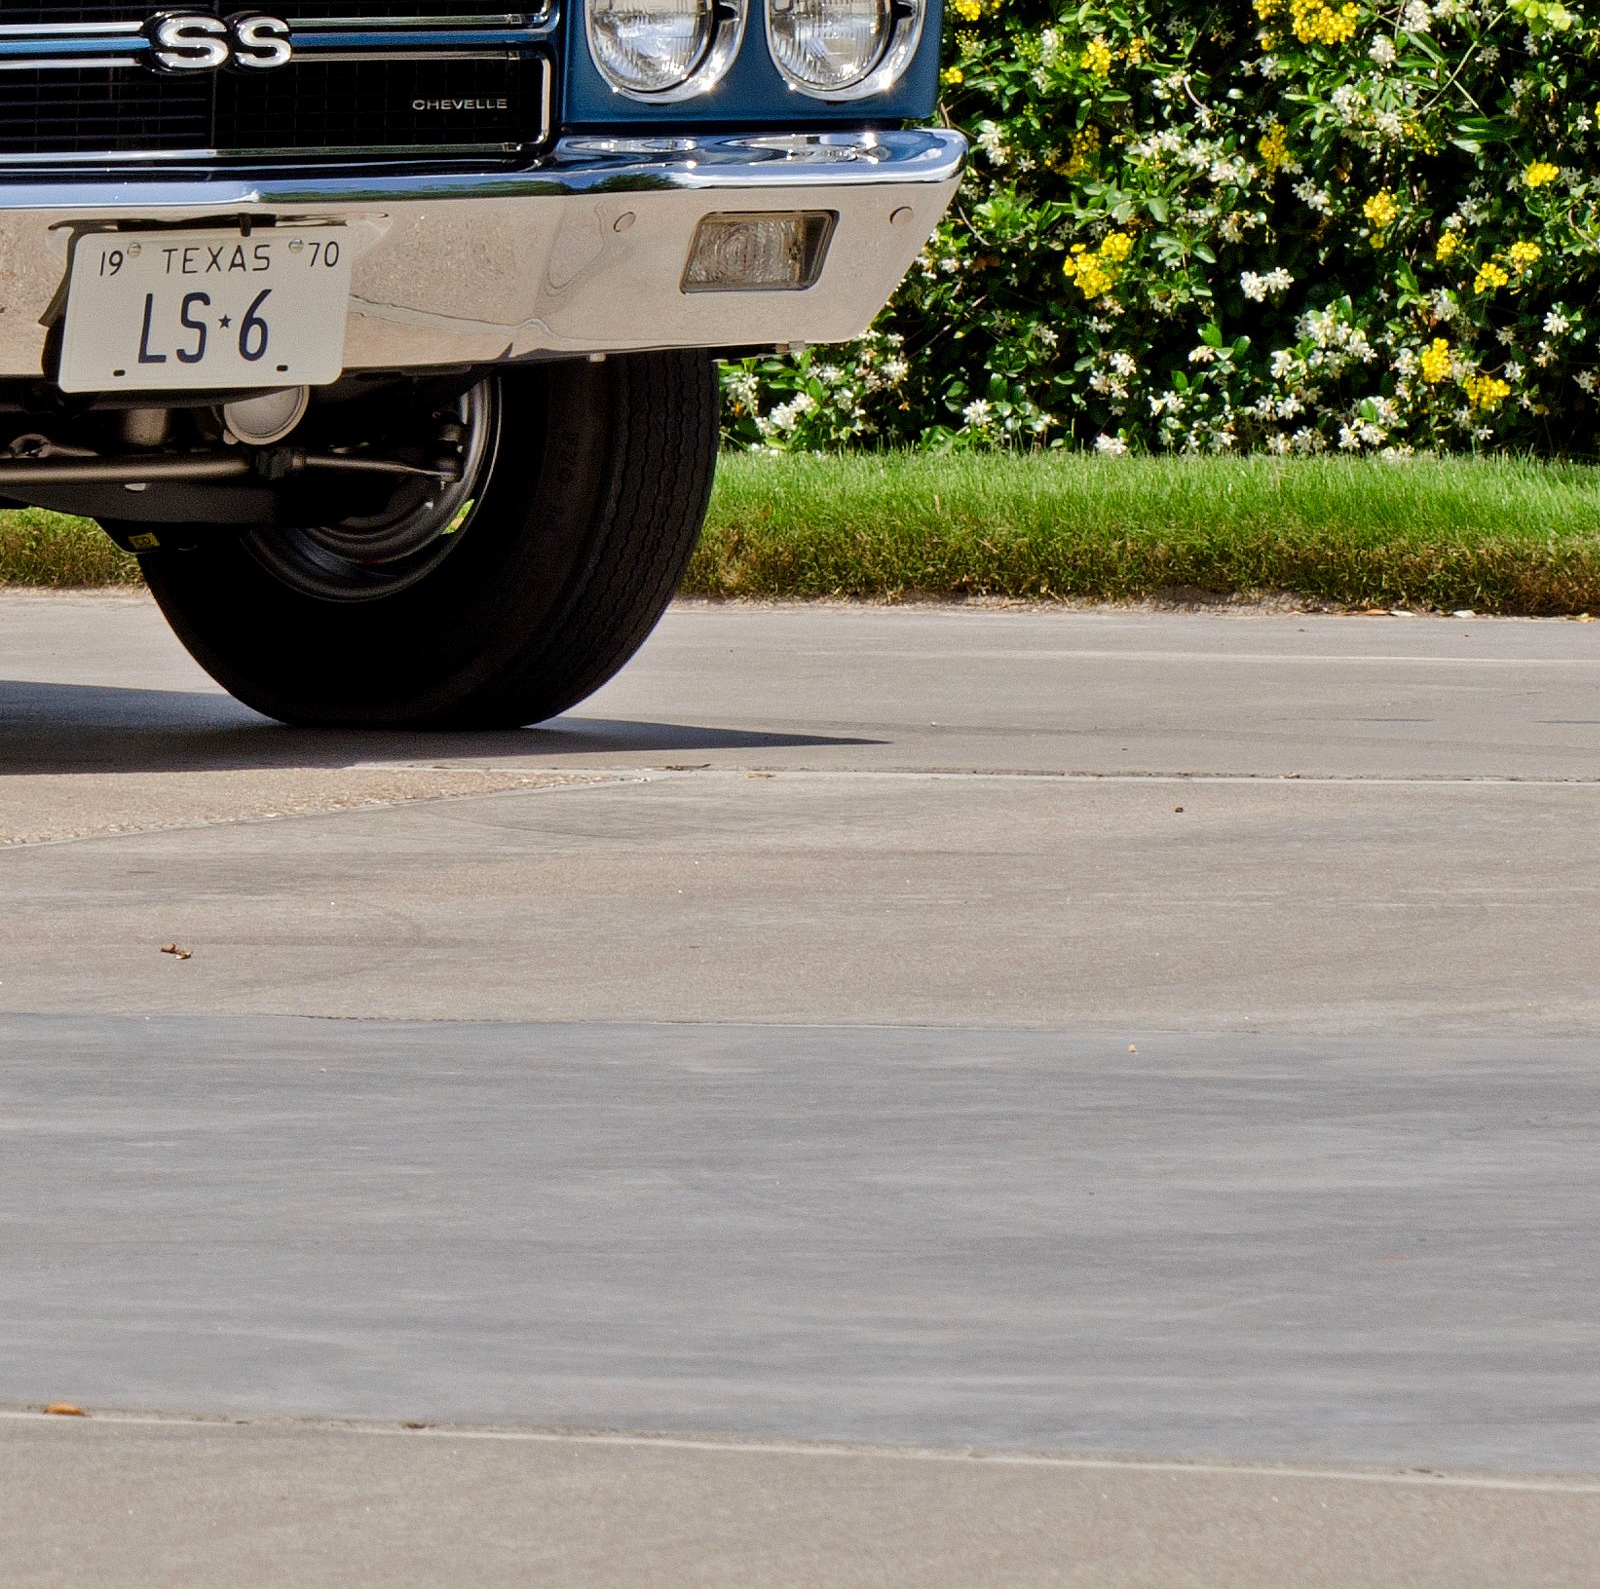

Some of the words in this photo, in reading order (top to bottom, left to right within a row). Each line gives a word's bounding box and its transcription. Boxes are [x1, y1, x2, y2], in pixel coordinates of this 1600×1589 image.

[157, 15, 293, 69] SS
[412, 98, 508, 111] CHEVELLE
[99, 250, 125, 276] 19
[162, 243, 272, 275] TEXAS
[308, 240, 340, 268] 70
